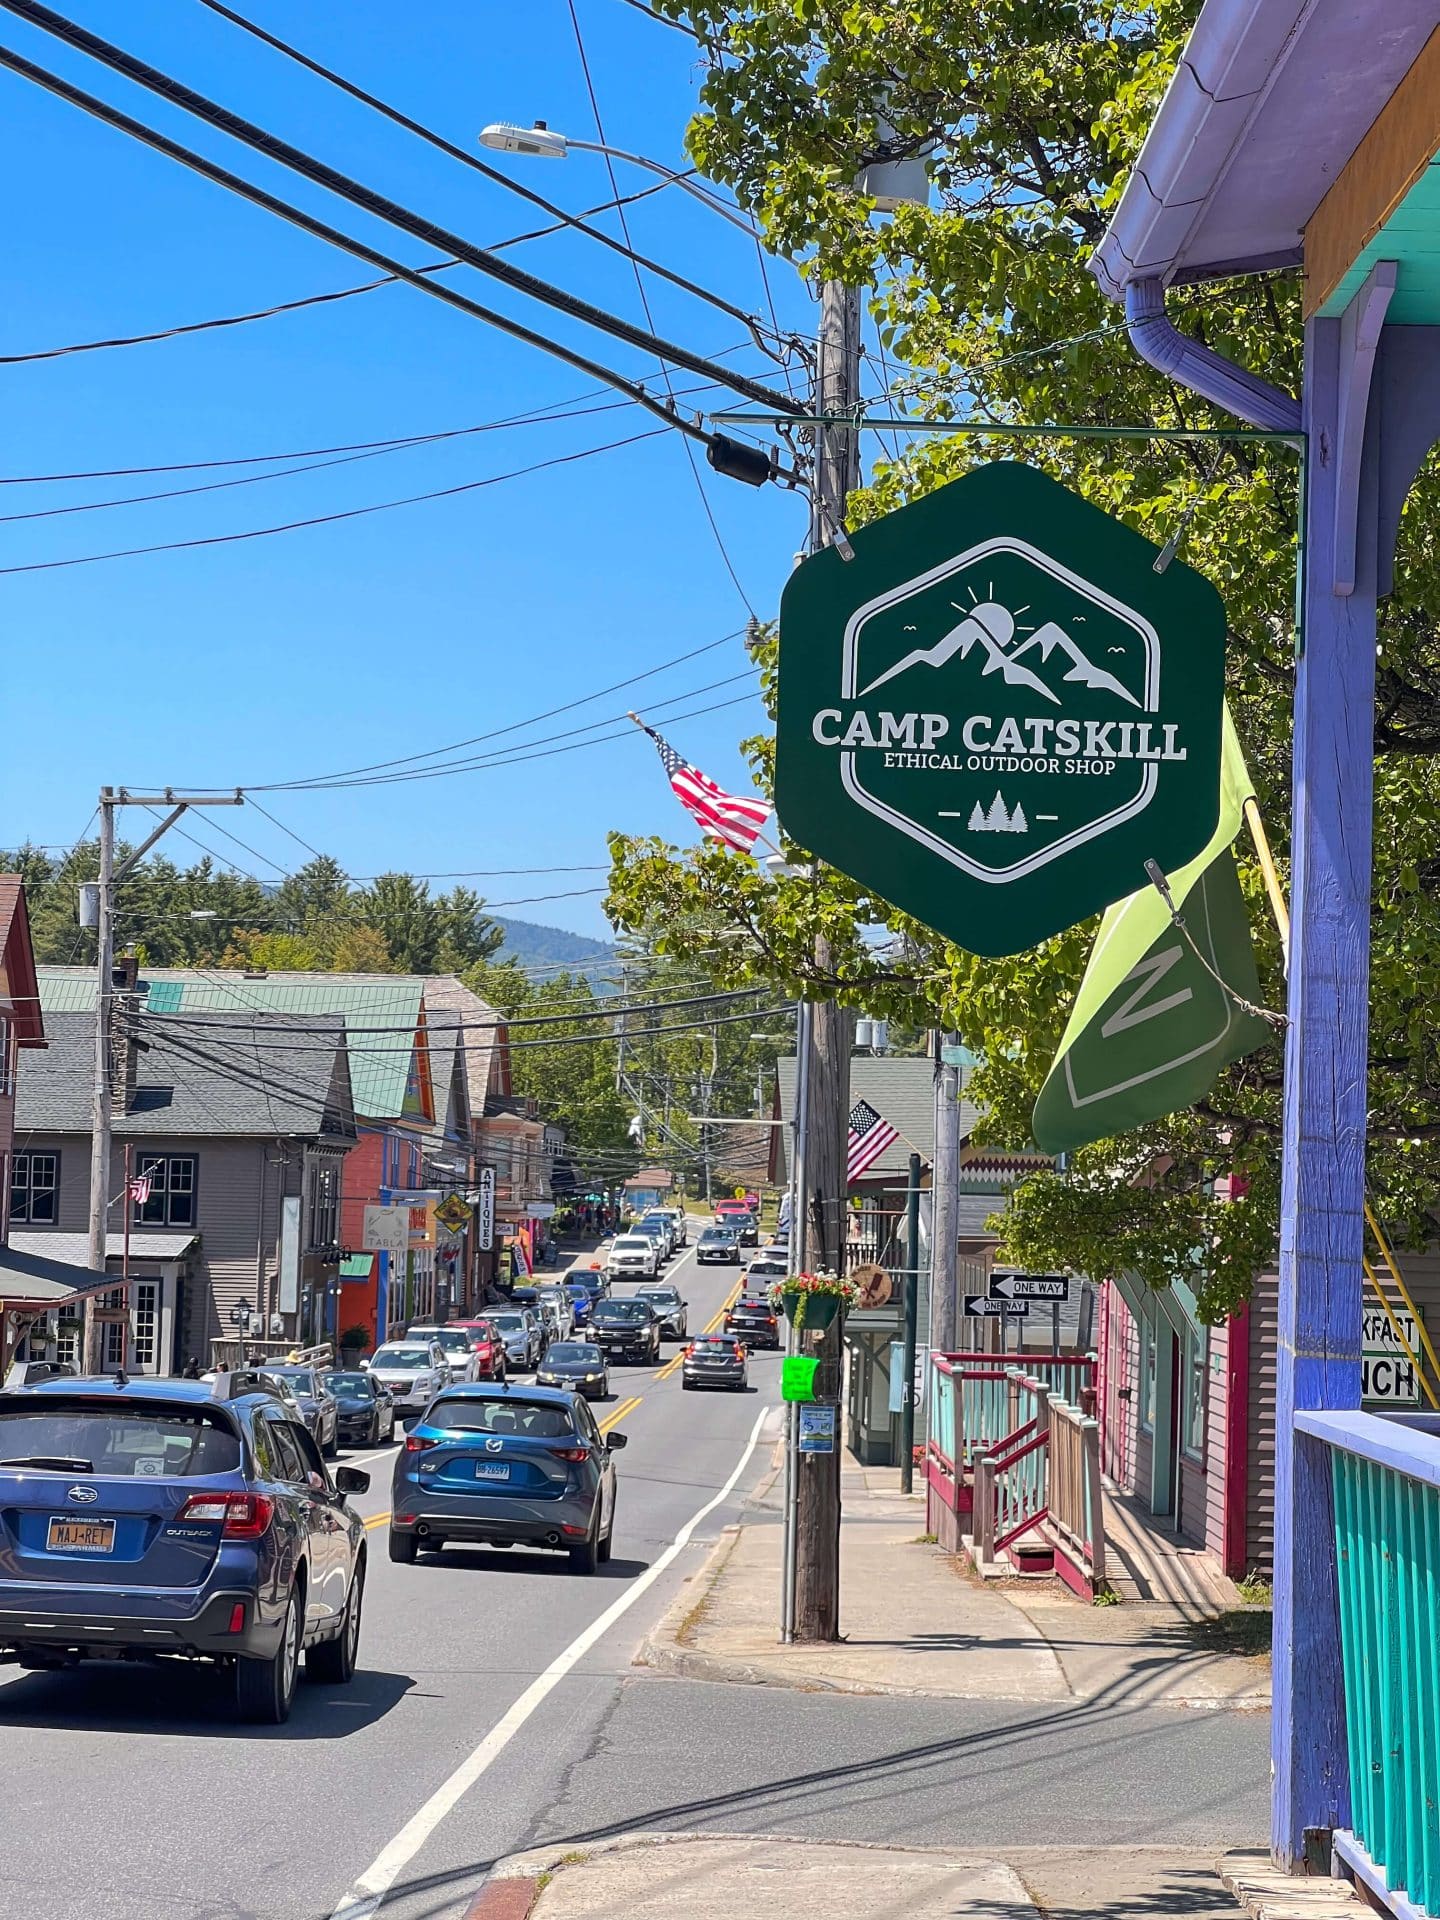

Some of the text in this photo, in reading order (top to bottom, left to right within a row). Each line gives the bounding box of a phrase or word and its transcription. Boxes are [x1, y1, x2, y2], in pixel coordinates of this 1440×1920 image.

[812, 708, 1187, 760] CAMP CATSKILL
[884, 752, 1116, 776] ETHICAL OUTDOOR SHOP
[483, 1170, 492, 1248] ANTIQUES
[368, 1238, 404, 1247] TABLA
[1014, 1282, 1061, 1293] ONE WAY
[984, 1302, 1001, 1310] ONE
[166, 1528, 213, 1537] OUTBACK
